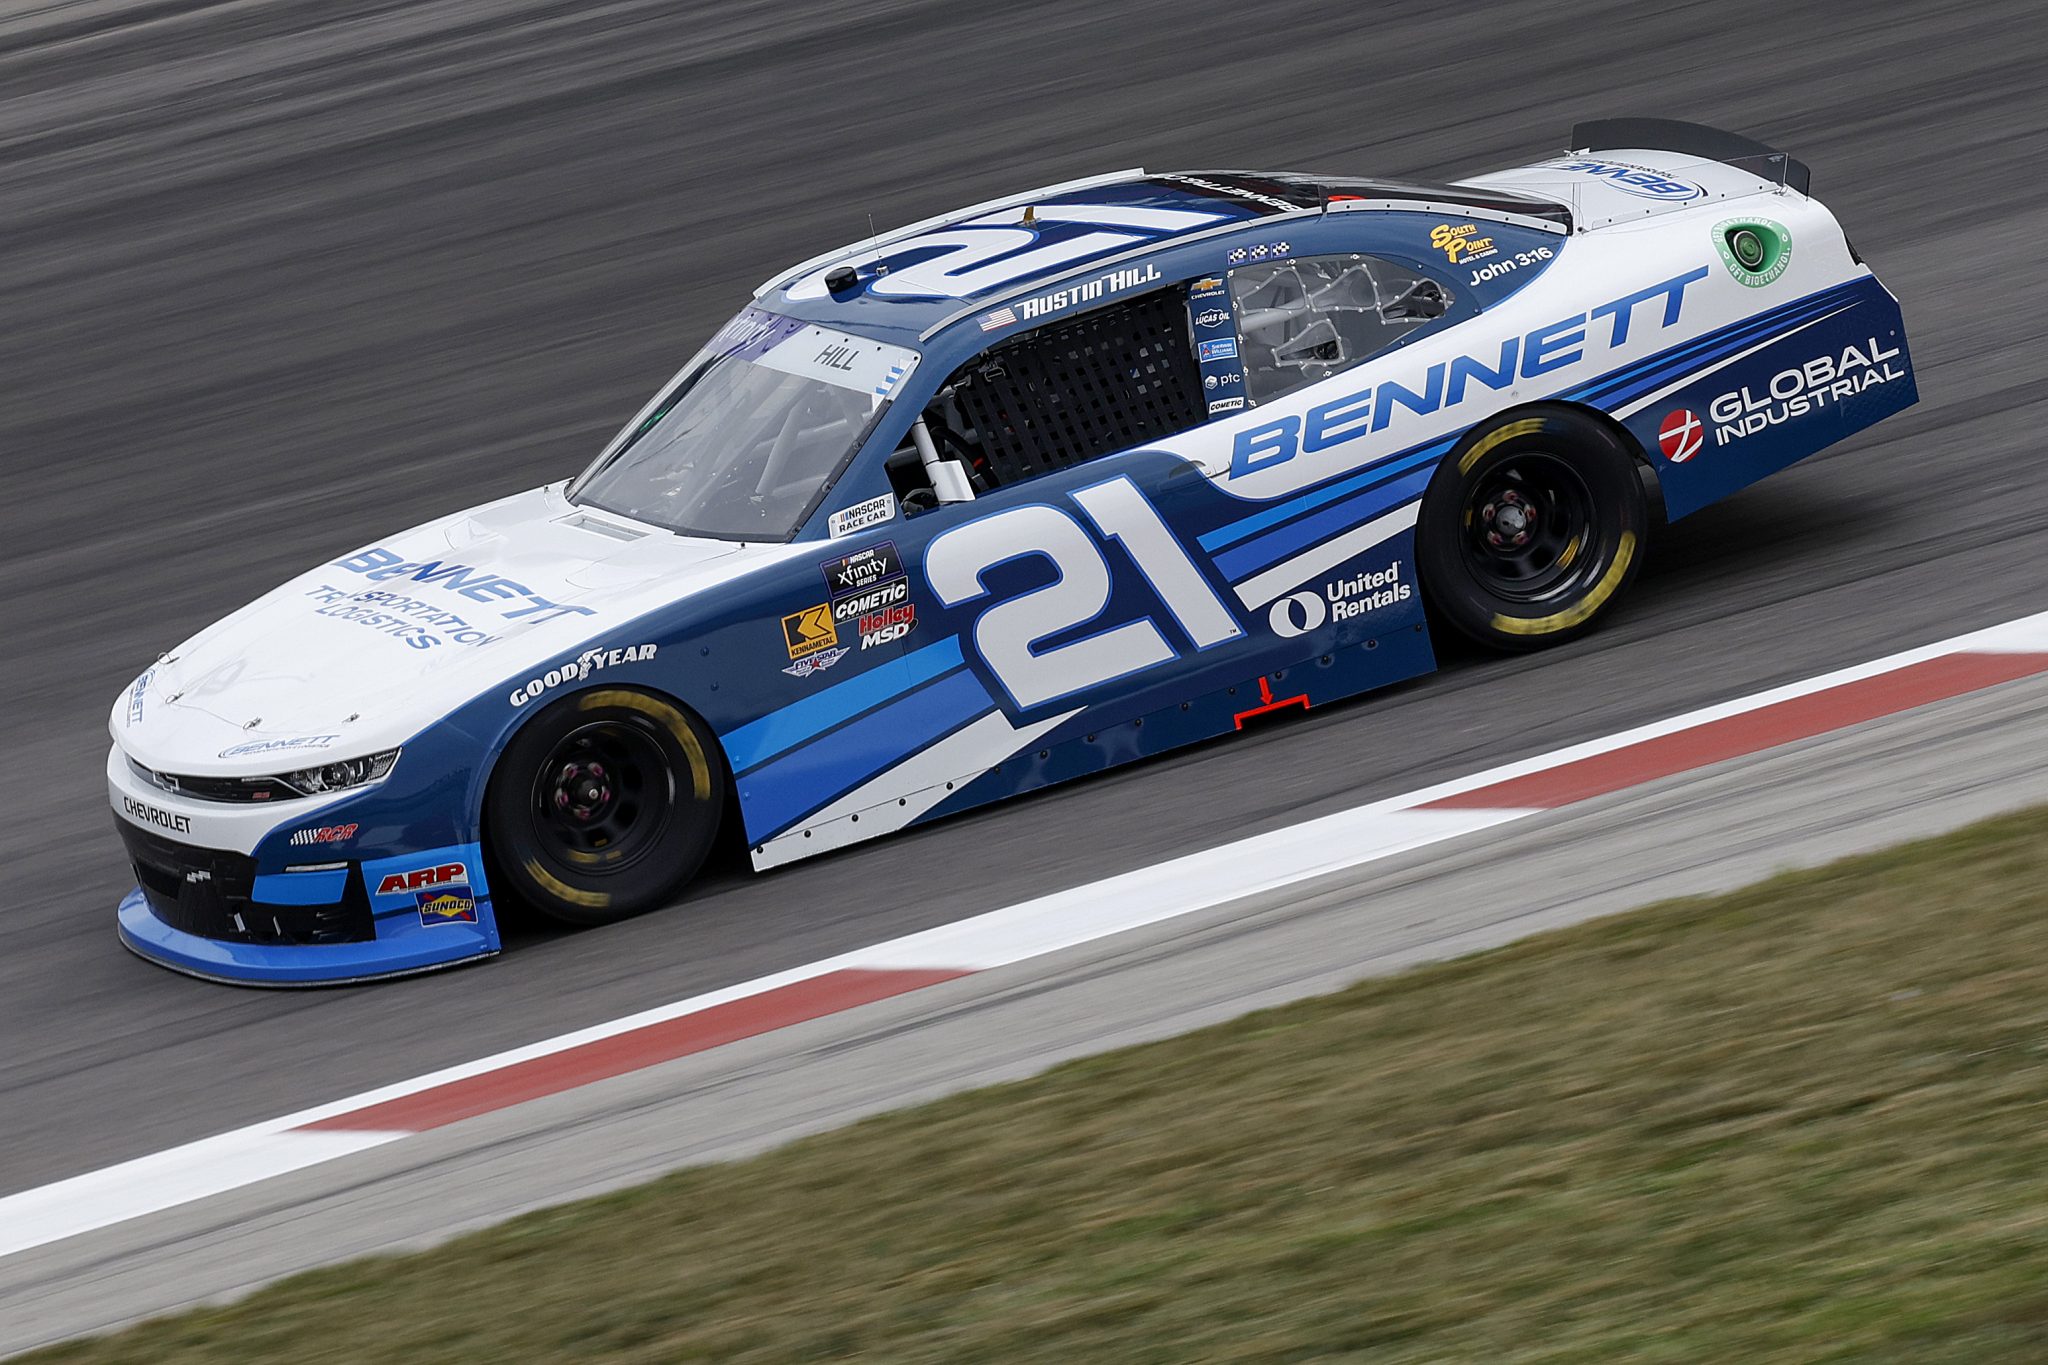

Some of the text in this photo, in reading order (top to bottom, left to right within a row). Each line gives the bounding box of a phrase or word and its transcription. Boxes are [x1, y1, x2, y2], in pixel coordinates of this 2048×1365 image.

[1430, 224, 1477, 248] SOUTH
[1444, 238, 1493, 263] POINT
[786, 204, 1236, 300] 21
[1470, 247, 1554, 286] John 3:16
[1729, 263, 1745, 280] GET
[1015, 264, 1162, 320] AUSTIN HILL
[1191, 290, 1225, 300] CHEVROLET
[1195, 312, 1230, 325] LUCAS OIL
[813, 344, 860, 371] HILL
[1220, 372, 1241, 387] ptc
[1228, 265, 1709, 480] BENNETT
[1709, 337, 1900, 423] GLOBAL
[1210, 399, 1243, 411] COMETIC
[1715, 363, 1905, 446] INDUSTRIAL
[839, 510, 887, 533] RACE CAR
[848, 498, 886, 519] NASCAR
[849, 549, 875, 564] NASCAR
[837, 557, 888, 586] xfinity
[856, 574, 877, 588] SERIES
[1326, 561, 1400, 601] United
[331, 548, 597, 625] BENNETT
[924, 475, 1246, 709] 21
[305, 585, 503, 647] TRNSPORTATION
[835, 583, 906, 620] COMETIC
[1332, 583, 1411, 623] Rentals
[316, 603, 441, 650] LOGISTICS
[859, 603, 915, 636] Holley
[791, 636, 834, 657] KENNAMETAL
[861, 623, 909, 651] MSD
[510, 644, 657, 707] GOODYEAR
[230, 735, 341, 755] BENNETT
[124, 796, 191, 834] CHEVROLET
[314, 823, 358, 842] RCR
[378, 863, 465, 893] ARP
[424, 900, 471, 913] SUNOCO
